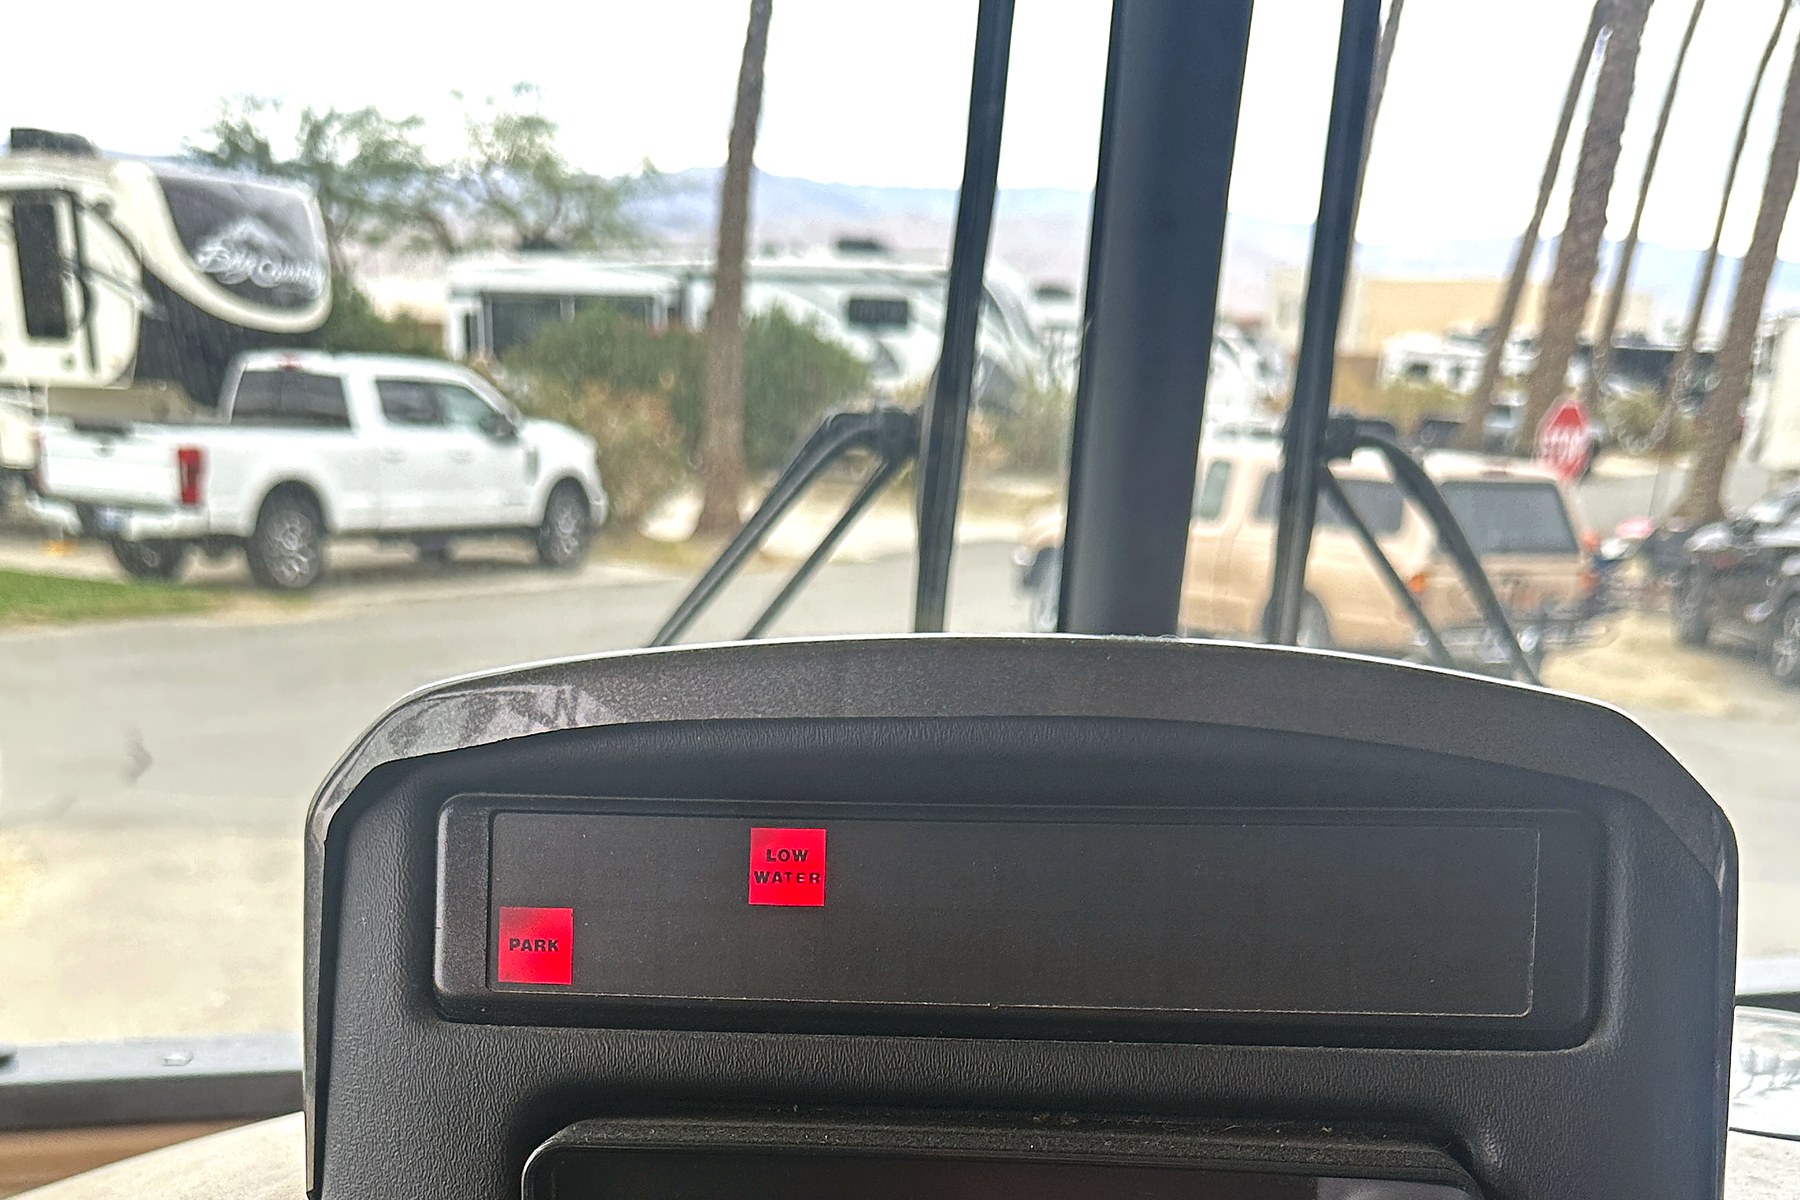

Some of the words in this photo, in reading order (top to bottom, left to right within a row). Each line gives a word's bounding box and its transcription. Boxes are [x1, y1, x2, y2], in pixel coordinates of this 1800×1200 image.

[766, 849, 808, 862] LOW
[754, 870, 821, 884] WATER
[509, 938, 559, 952] PARK
